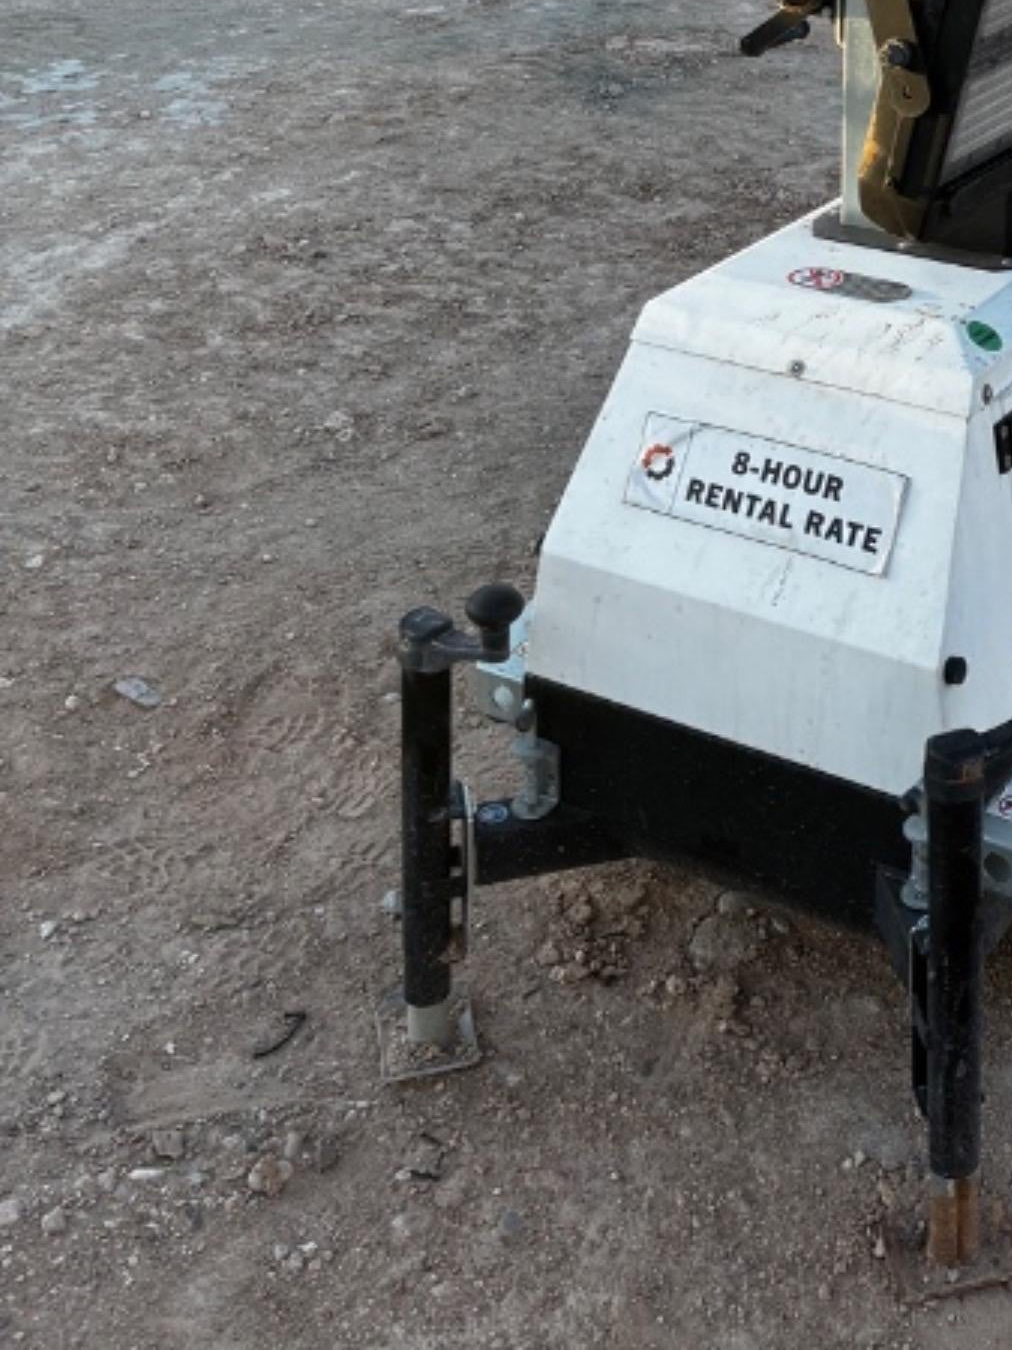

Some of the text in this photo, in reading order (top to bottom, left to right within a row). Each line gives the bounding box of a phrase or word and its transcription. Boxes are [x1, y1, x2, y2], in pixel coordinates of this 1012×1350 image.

[731, 451, 844, 502] 8-HOUR
[685, 478, 883, 555] RENTAL RATE
